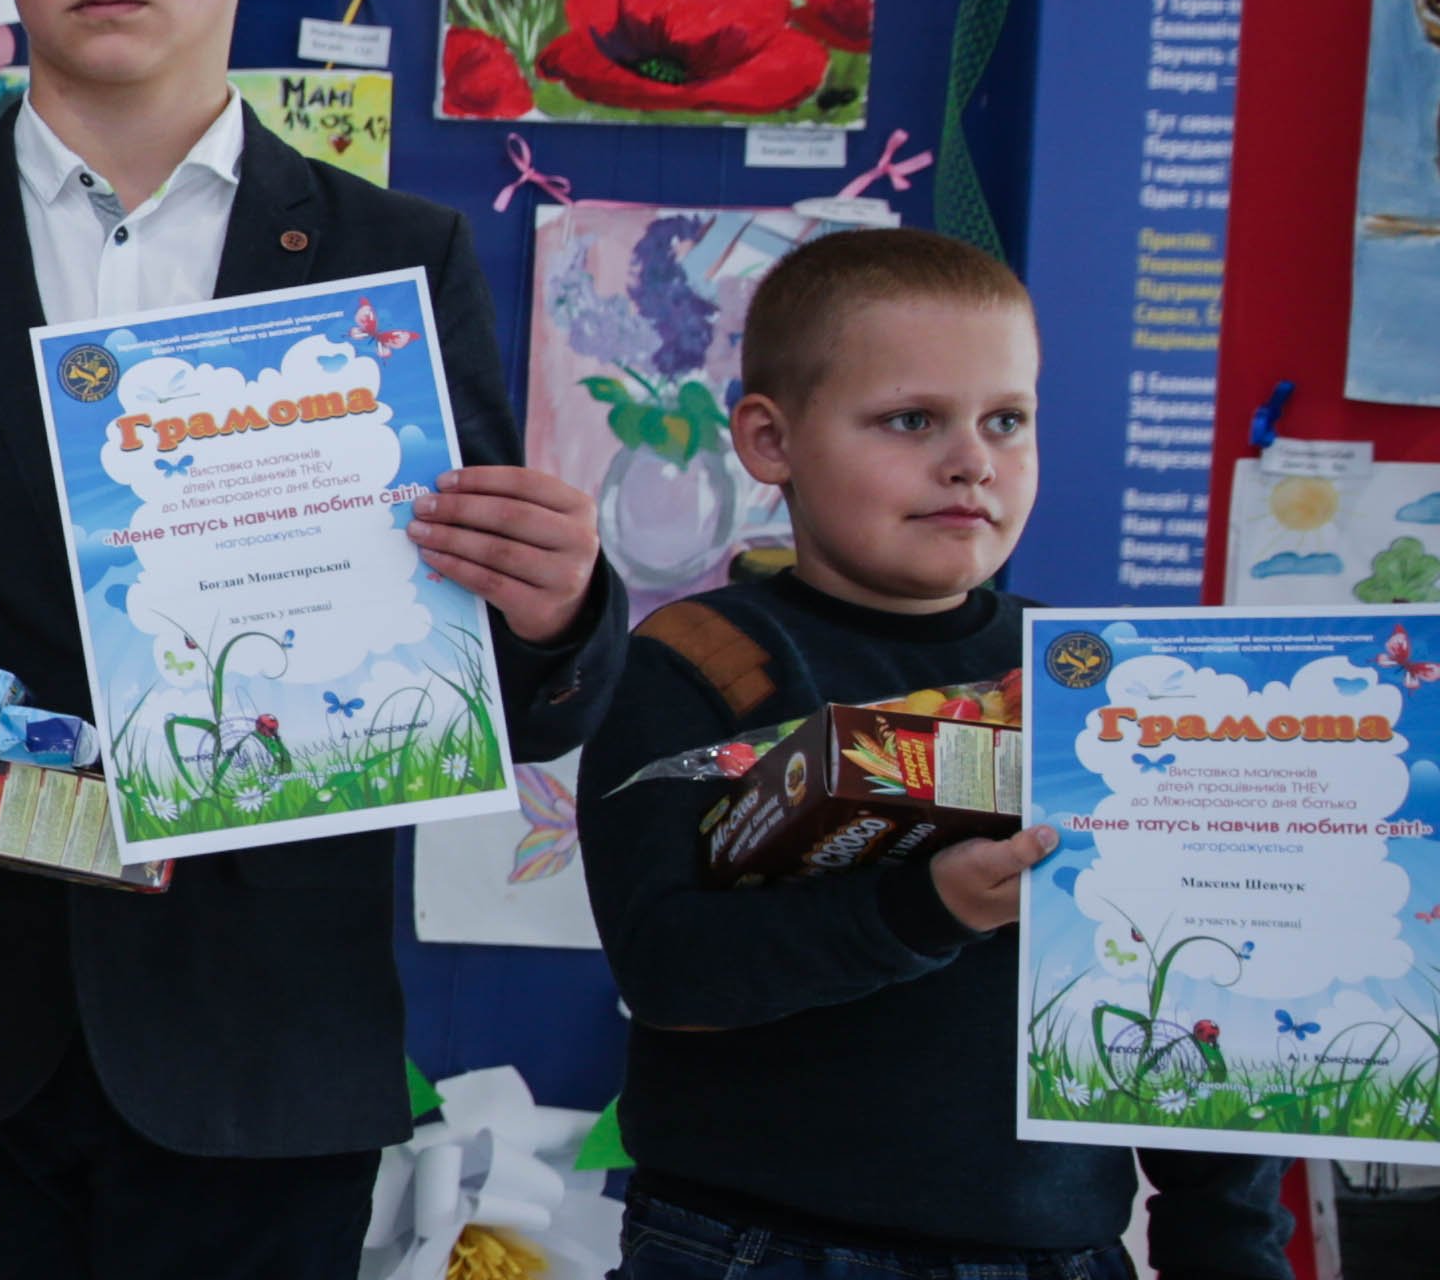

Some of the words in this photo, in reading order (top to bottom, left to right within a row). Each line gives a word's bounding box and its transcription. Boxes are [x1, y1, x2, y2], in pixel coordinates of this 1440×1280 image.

[116, 386, 380, 452] Грамота
[189, 461, 254, 478] Виставка
[256, 448, 321, 466] малюнків
[104, 524, 165, 547] «Мене
[170, 517, 229, 538] татусь
[233, 507, 298, 527] навчив
[302, 495, 374, 516] любити
[379, 484, 430, 505] світ!»
[198, 577, 245, 593] Богдан
[247, 560, 352, 584] Монастирський
[1098, 706, 1394, 748] Грамота
[1168, 765, 1240, 778] Виставка
[1244, 767, 1318, 779] малюнків
[1156, 781, 1194, 793] дітей
[1198, 782, 1287, 795] працівників
[1130, 797, 1149, 808] до
[1154, 795, 1268, 811] Міжнародного
[1272, 798, 1297, 810] дня
[1302, 797, 1357, 810] батька
[1062, 815, 1130, 832] «Мене
[1136, 819, 1201, 837] татусь
[1207, 818, 1280, 834] навчив
[1286, 818, 1368, 836] любити
[1375, 821, 1433, 838] світ!»
[1180, 876, 1240, 890] Максим
[1244, 878, 1306, 893] Шевчук
